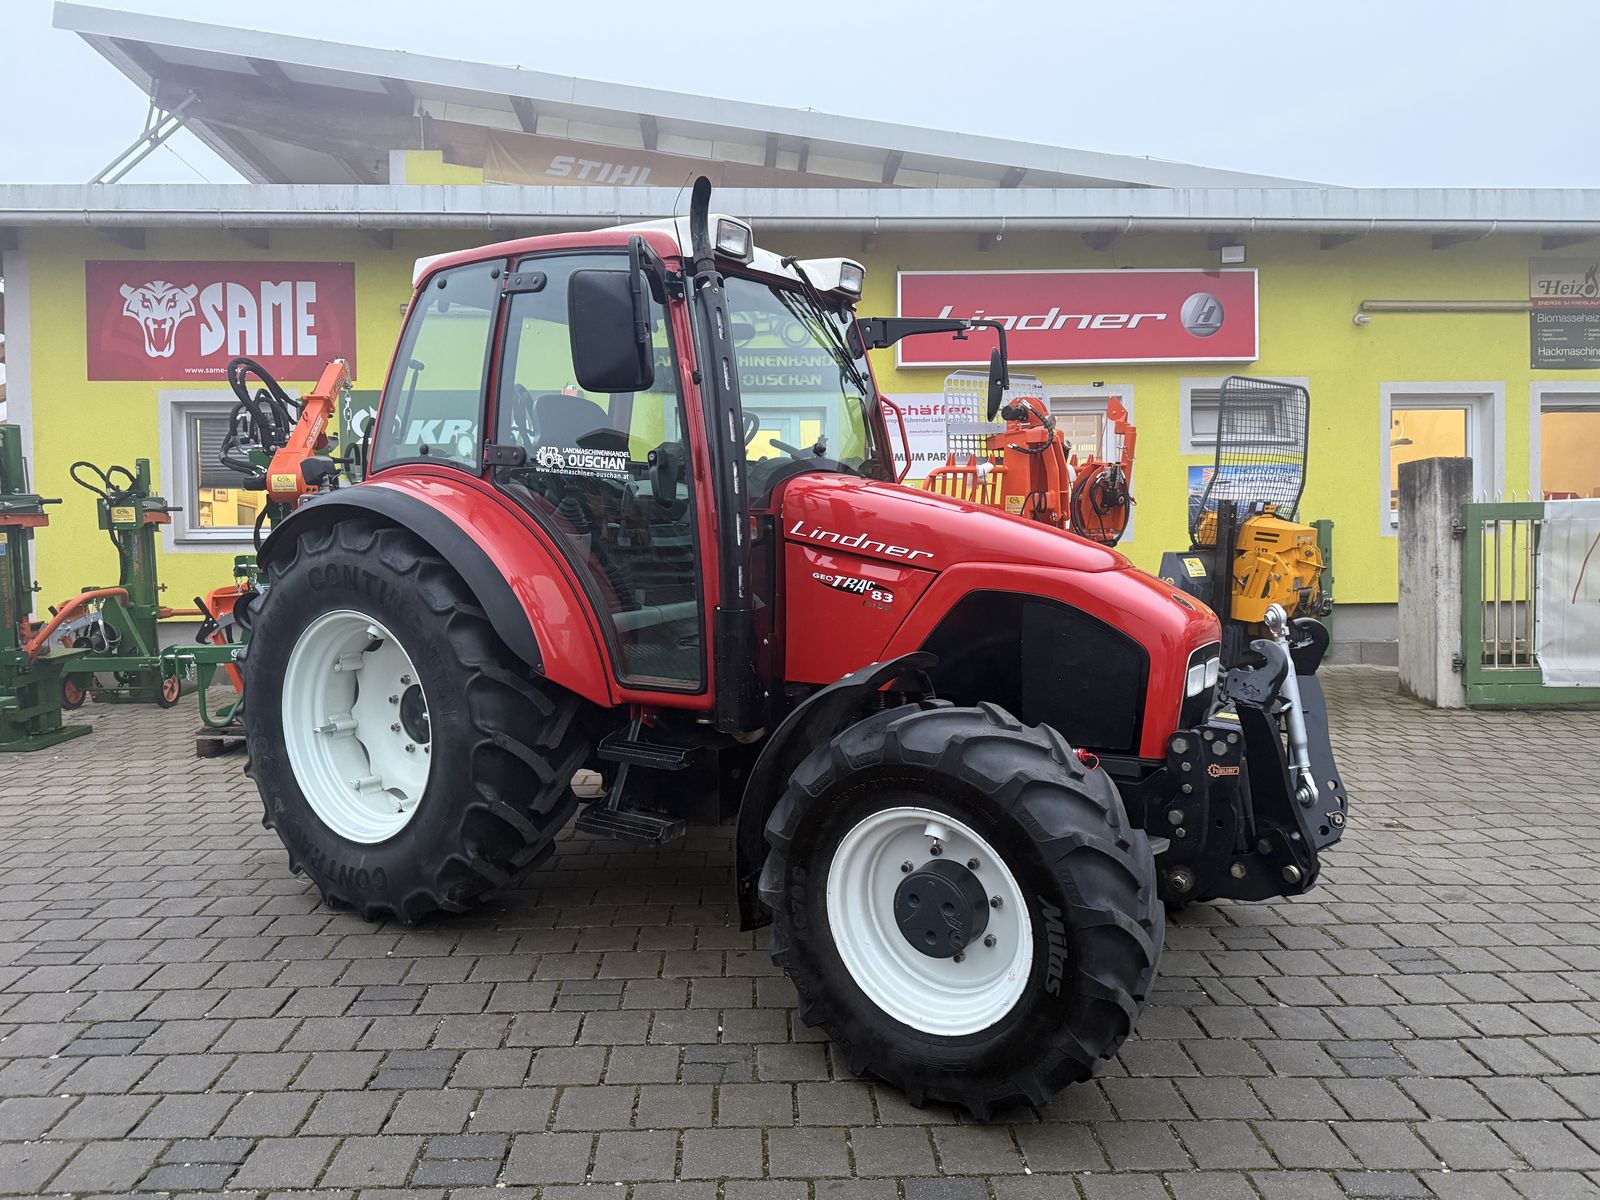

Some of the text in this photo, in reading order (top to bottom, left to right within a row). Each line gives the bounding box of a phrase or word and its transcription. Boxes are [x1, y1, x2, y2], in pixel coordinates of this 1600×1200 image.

[545, 155, 658, 186] STIHL
[199, 280, 317, 356] SAME
[743, 374, 822, 386] OUSCHAN
[562, 447, 630, 458] LANDMASCHINENHANDEL
[568, 454, 626, 471] OUSCHAN
[535, 466, 629, 480] www.landmaschinen-ouschan.at
[790, 520, 935, 560] Lindner
[871, 590, 893, 603] 83
[1036, 894, 1069, 998] Mitas
